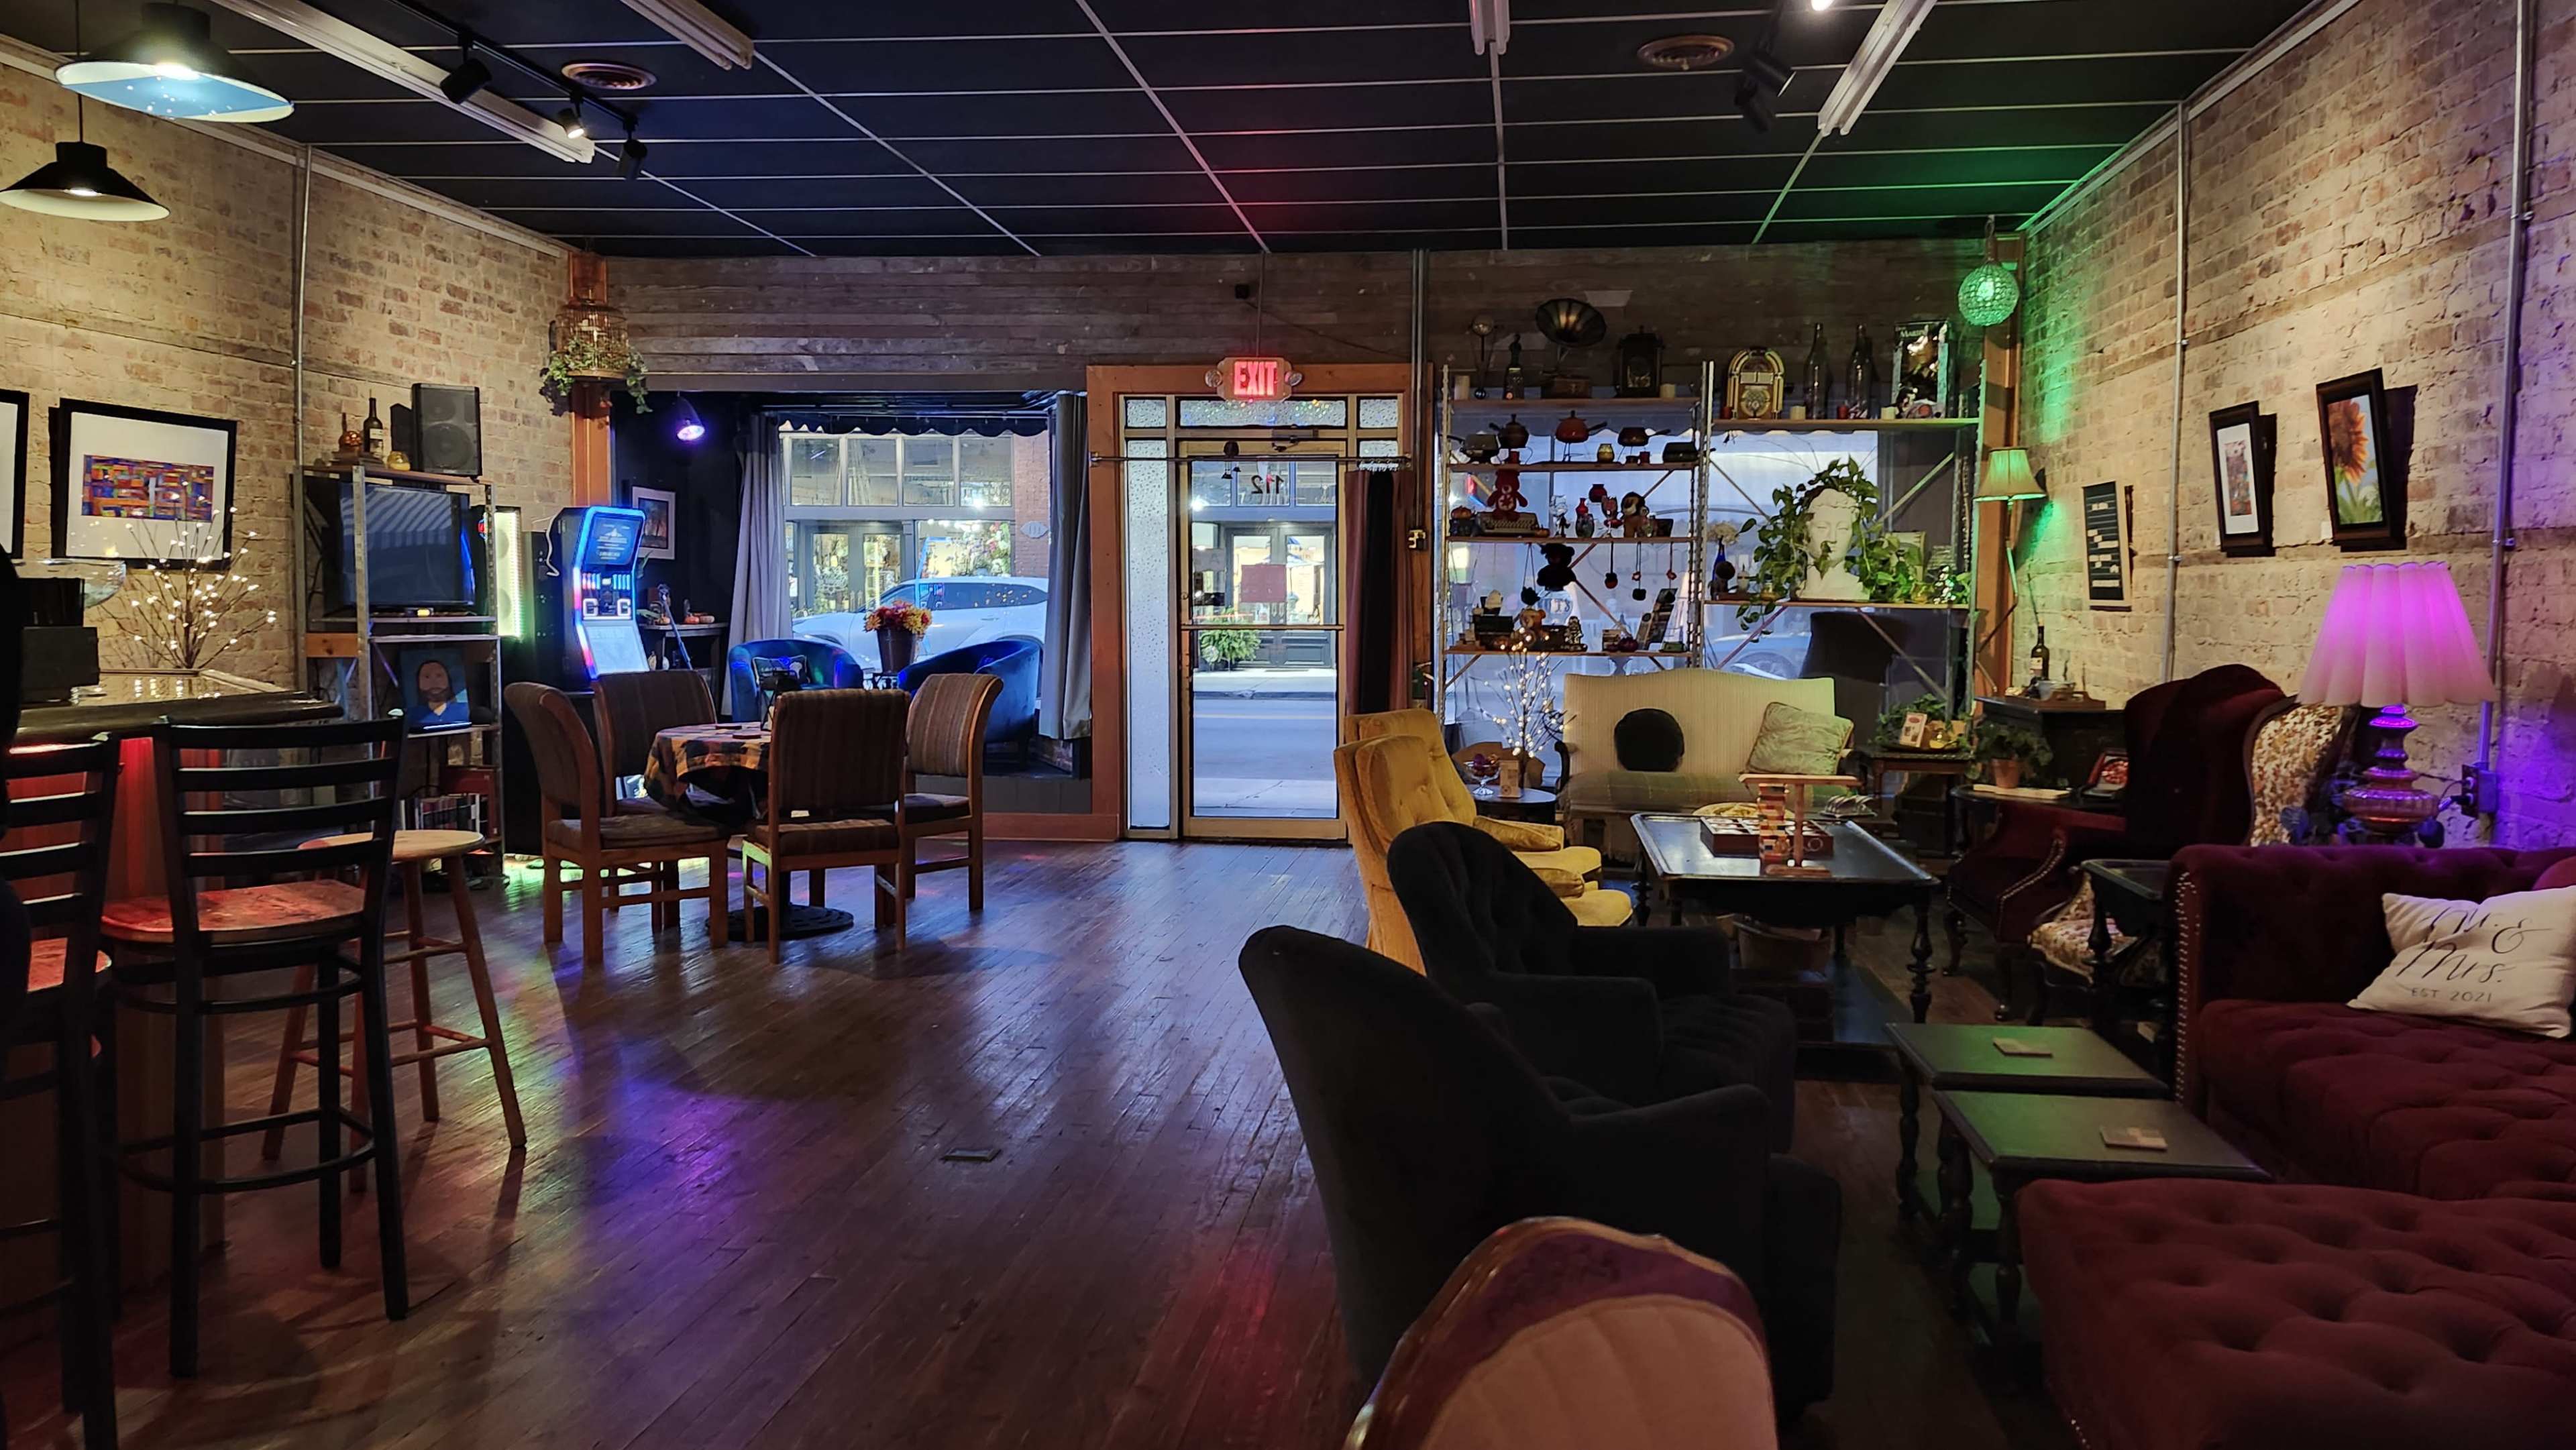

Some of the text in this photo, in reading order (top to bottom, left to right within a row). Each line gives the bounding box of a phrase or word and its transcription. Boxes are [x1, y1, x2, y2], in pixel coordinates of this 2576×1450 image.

[1234, 361, 1277, 396] EXIT
[2491, 917, 2555, 954] &
[2396, 940, 2516, 983] Mrs.
[2412, 988, 2493, 1003] EST 2021
